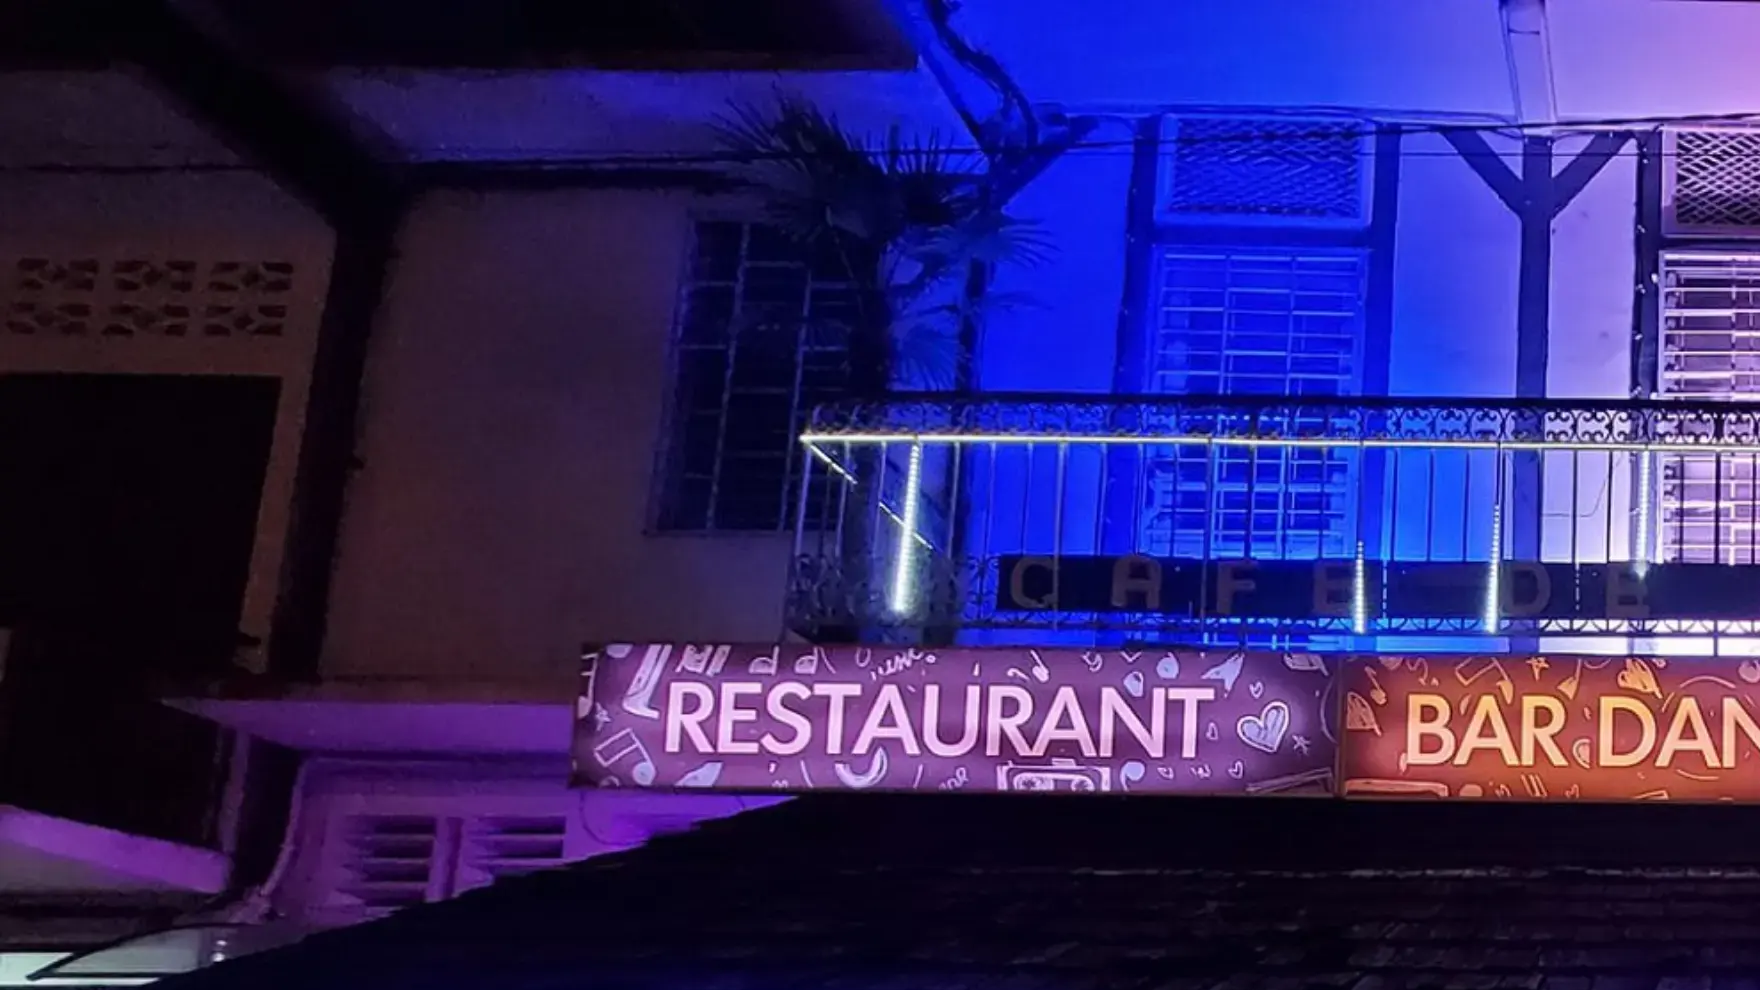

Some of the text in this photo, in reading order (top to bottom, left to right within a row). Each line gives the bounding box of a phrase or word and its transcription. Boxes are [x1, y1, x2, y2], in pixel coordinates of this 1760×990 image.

[1010, 556, 1366, 615] CAFE
[1503, 561, 1650, 617] DE
[664, 682, 1214, 758] RESTAURANT
[1406, 694, 1569, 767] BAR
